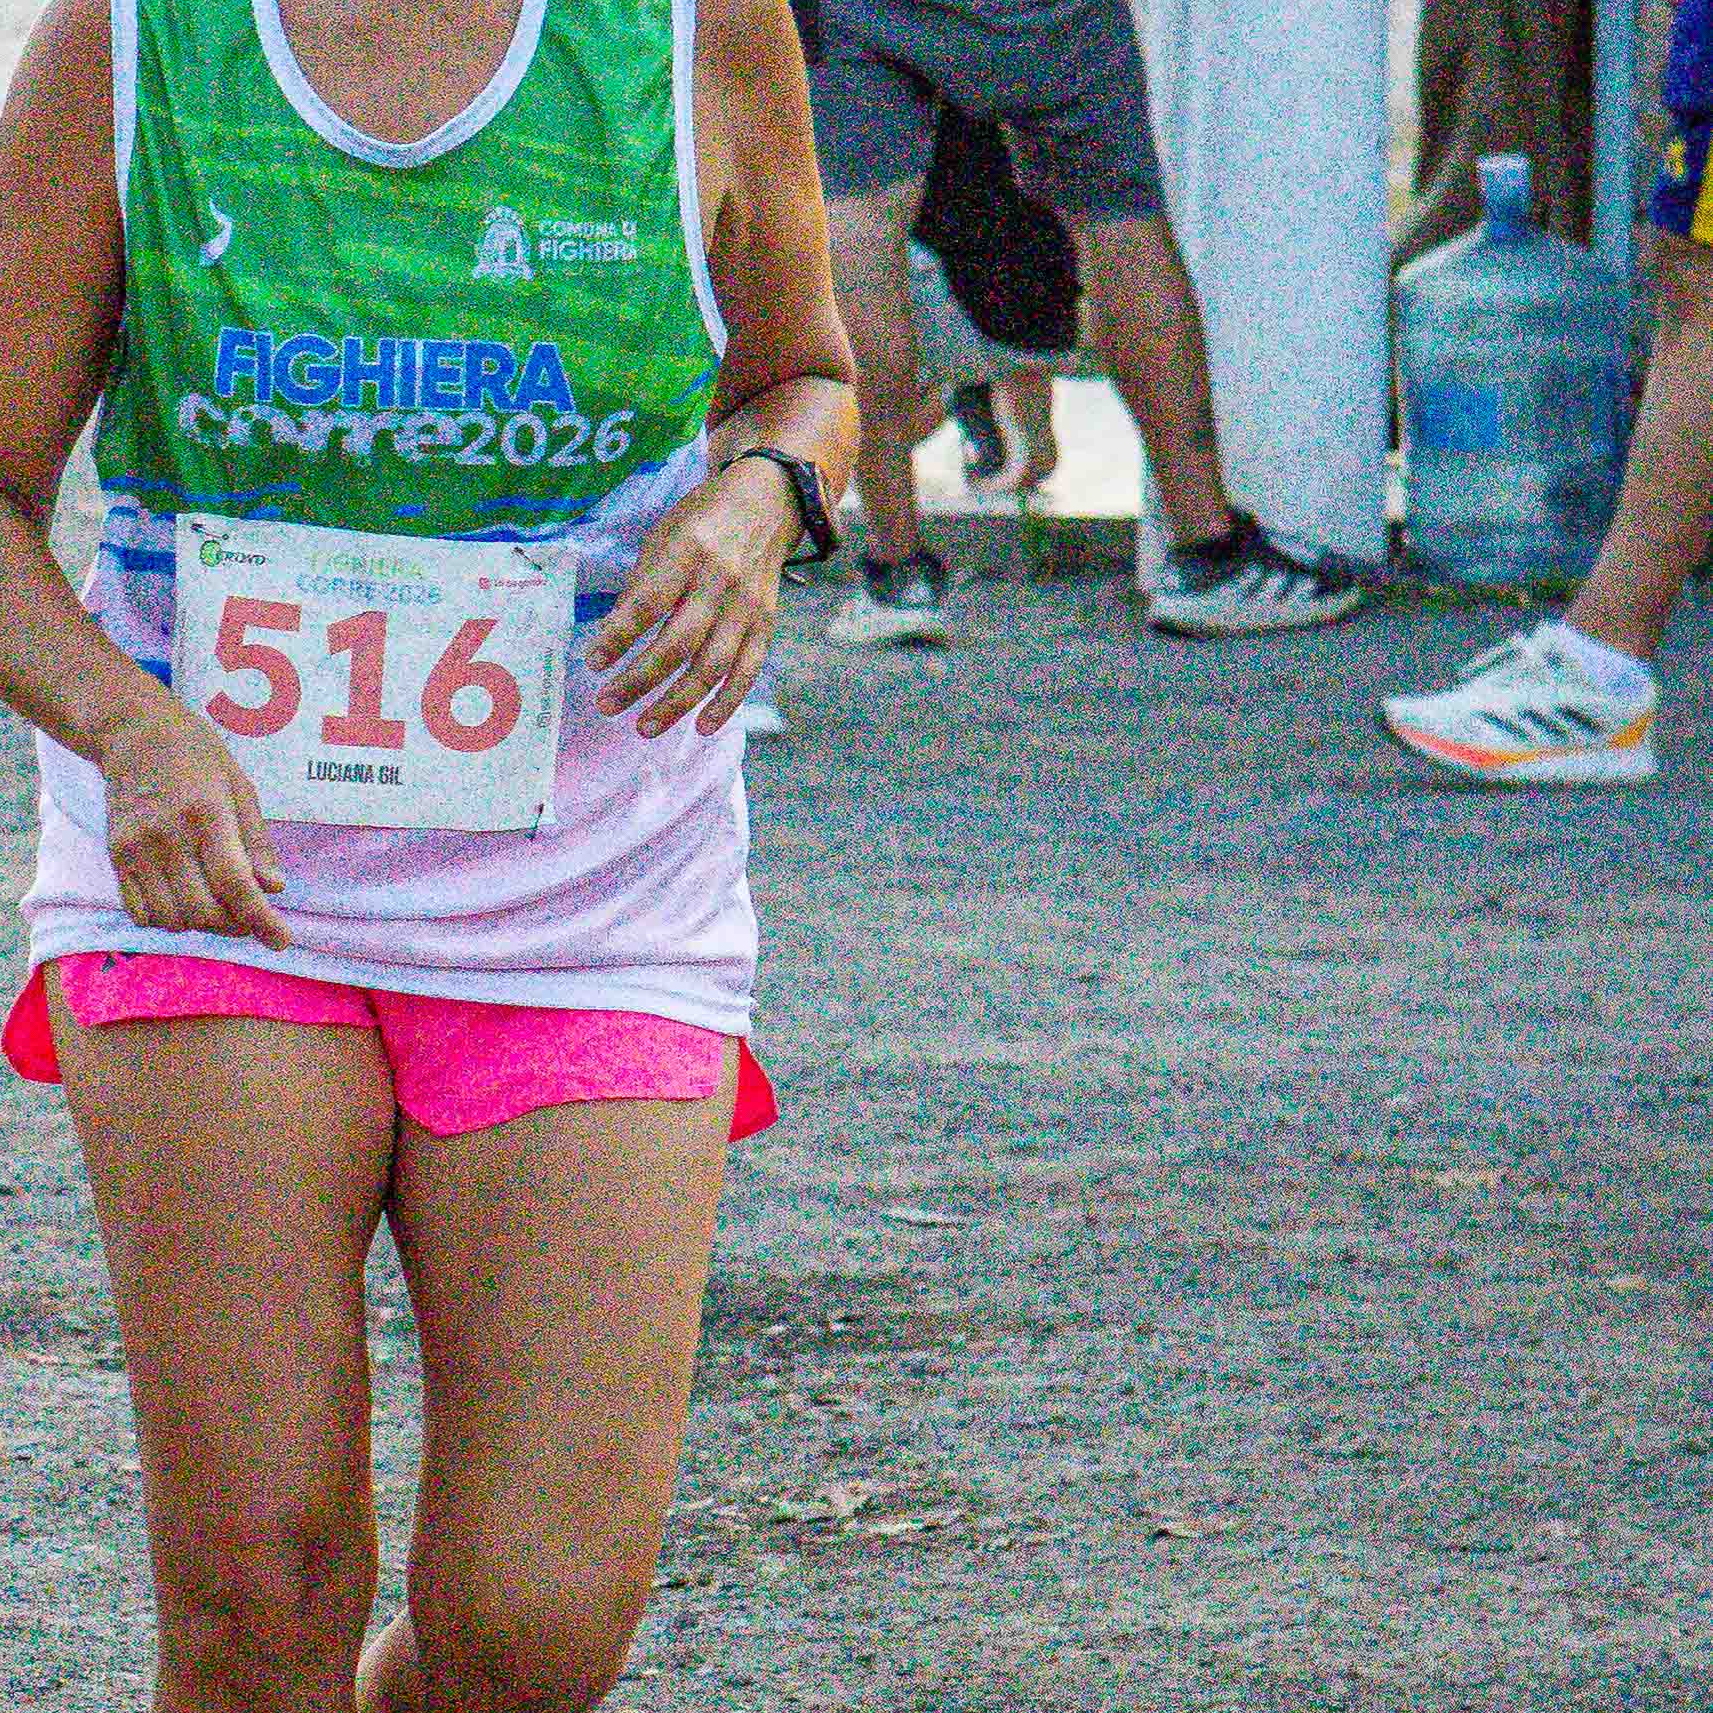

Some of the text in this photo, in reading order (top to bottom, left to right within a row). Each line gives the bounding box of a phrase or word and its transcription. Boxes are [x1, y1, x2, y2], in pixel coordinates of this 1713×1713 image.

[214, 325, 575, 413] FIGHIERA
[204, 595, 522, 753] 516
[307, 760, 404, 786] LUCIANA GIL
